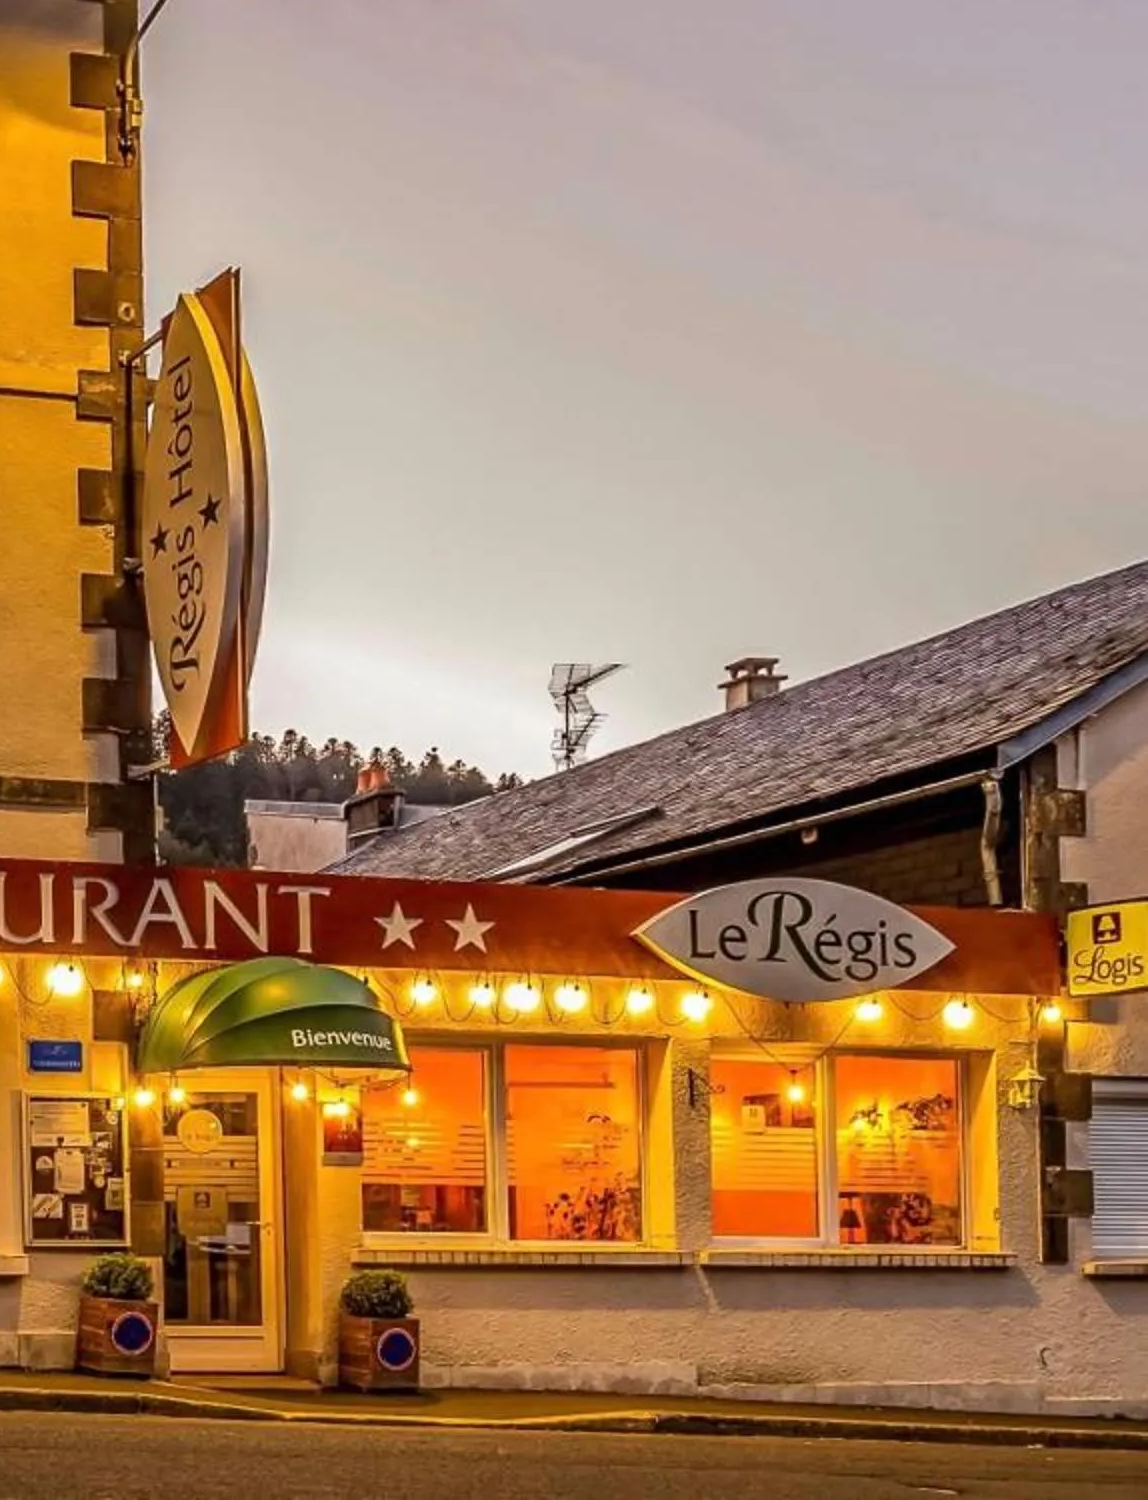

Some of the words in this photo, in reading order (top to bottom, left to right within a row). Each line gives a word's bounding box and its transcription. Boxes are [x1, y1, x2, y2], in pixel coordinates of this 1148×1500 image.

[167, 355, 193, 508] Hôtel
[169, 525, 207, 694] Régis
[688, 909, 748, 962] Le
[747, 890, 918, 983] Régis
[1074, 946, 1144, 986] Logis
[291, 1028, 393, 1052] Bienvenue
